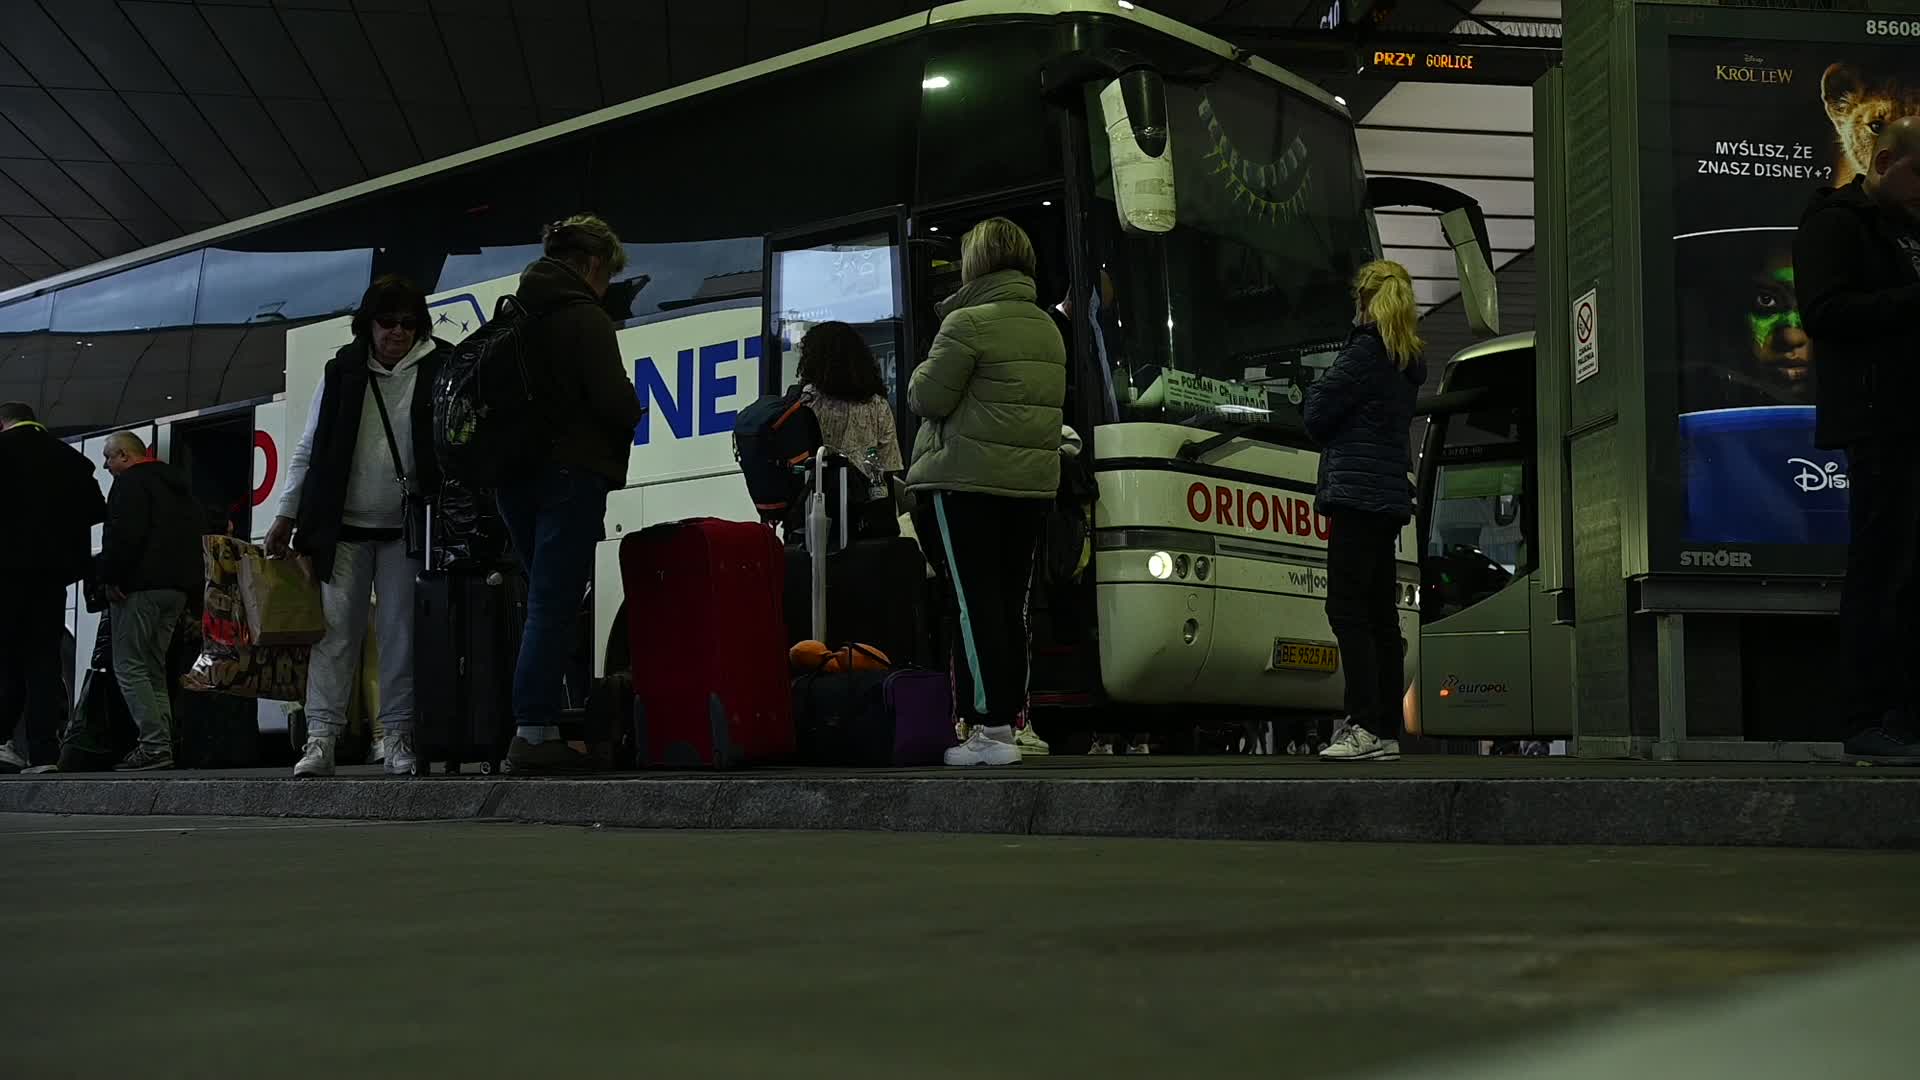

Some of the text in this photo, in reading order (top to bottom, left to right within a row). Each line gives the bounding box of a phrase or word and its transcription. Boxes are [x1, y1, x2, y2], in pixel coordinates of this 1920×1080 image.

[1373, 51, 1473, 70] PRZY GORLICE
[1715, 140, 1813, 161] MYŚLISZ, ŻE
[1697, 160, 1833, 180] ZNASZ DISNEY+?
[1187, 482, 1331, 541] ORIONBU
[1282, 645, 1296, 663] BE
